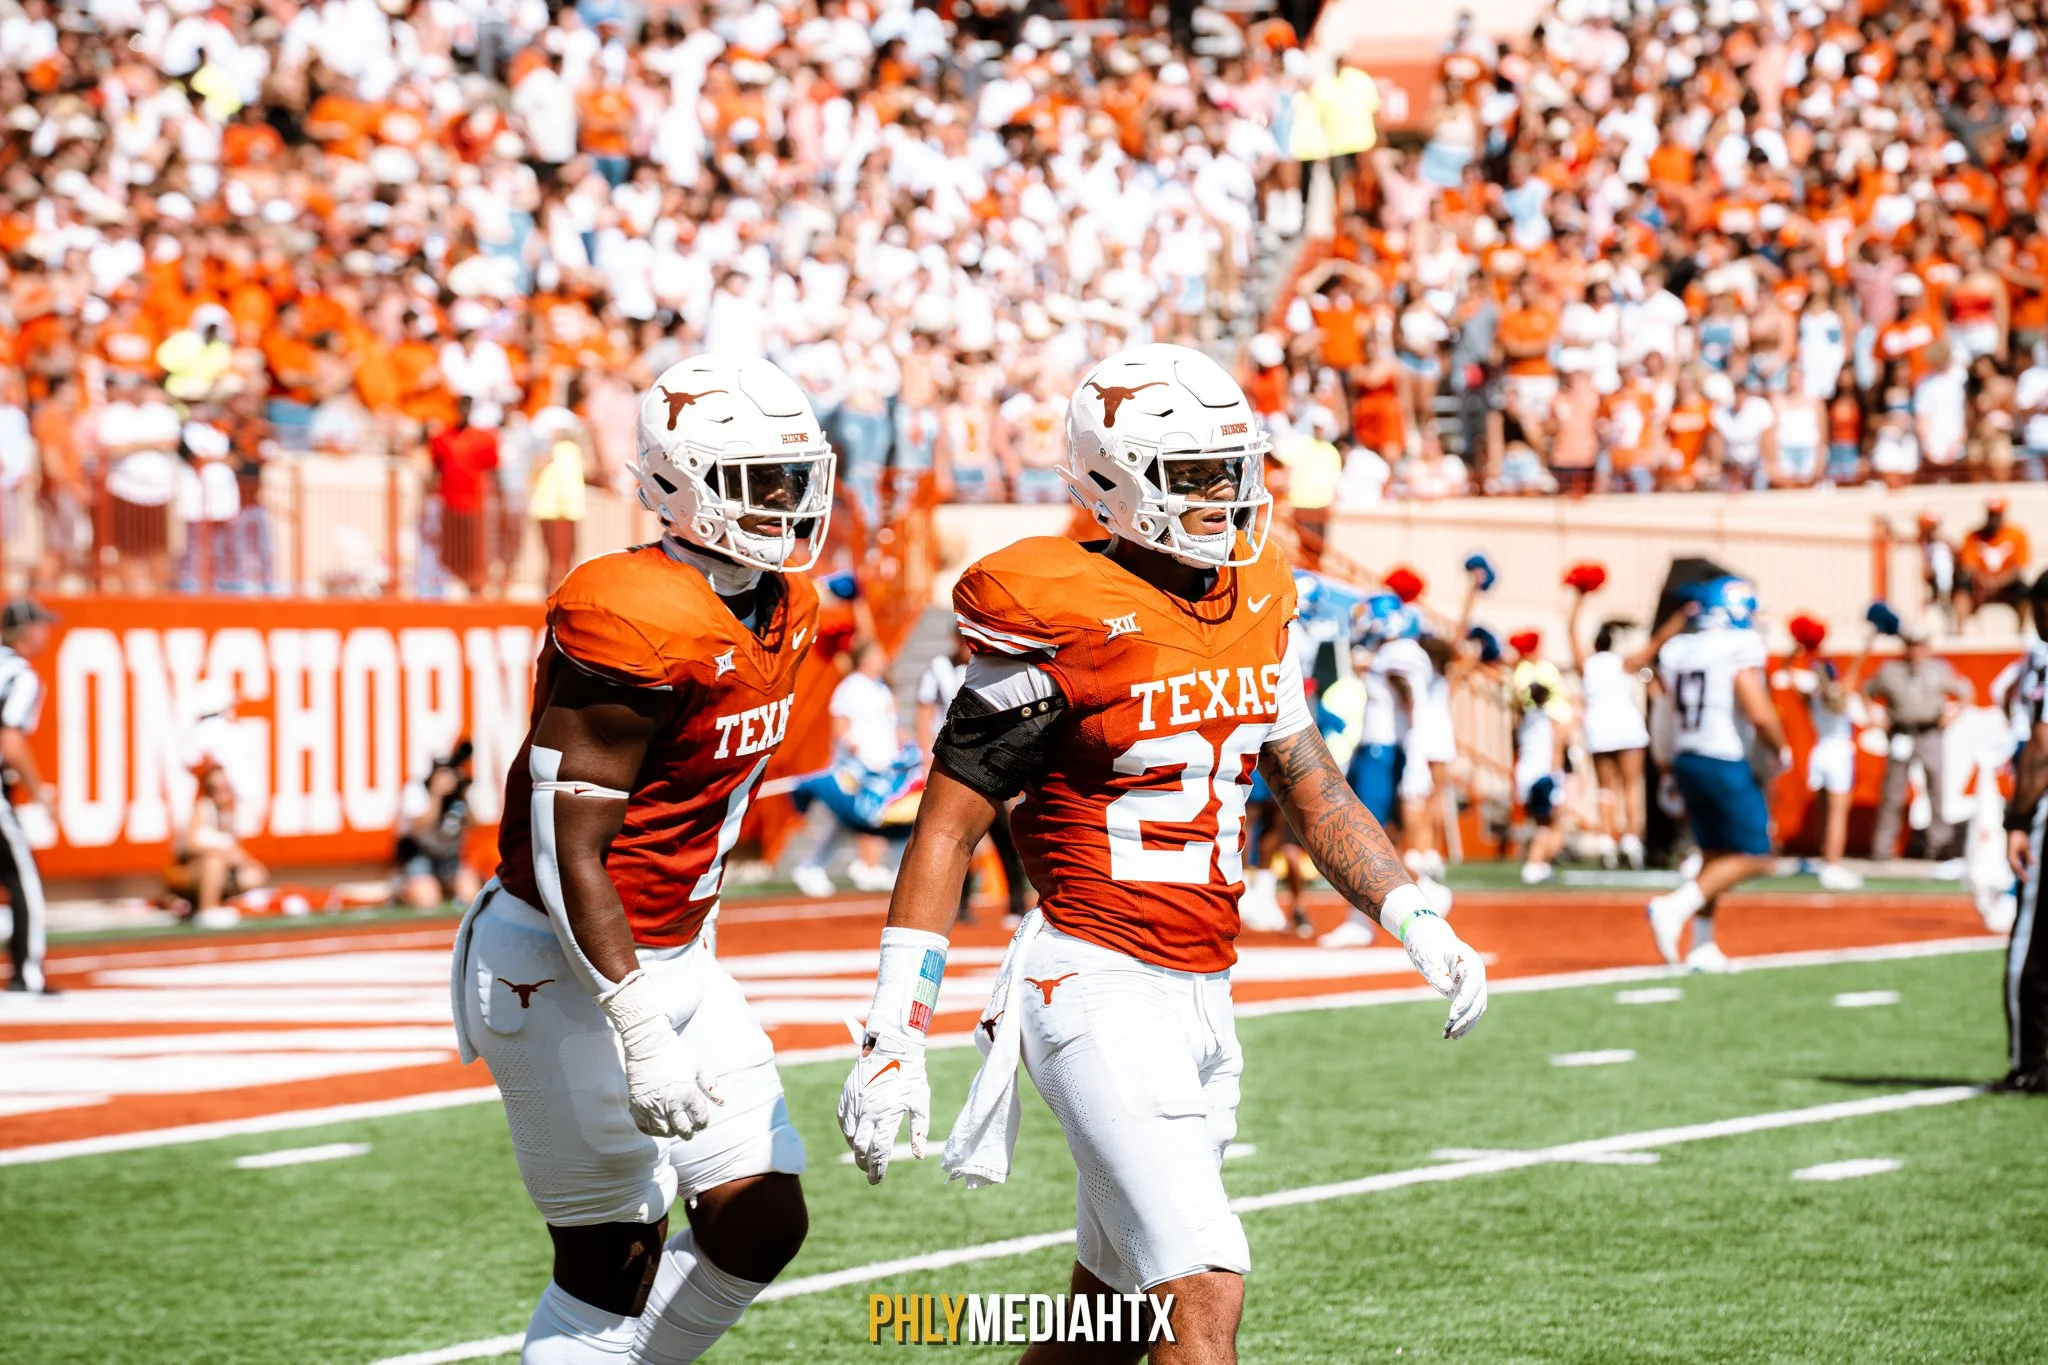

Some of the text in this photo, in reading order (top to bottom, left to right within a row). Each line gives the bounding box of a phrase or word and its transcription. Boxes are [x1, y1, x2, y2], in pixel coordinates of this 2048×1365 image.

[714, 692, 795, 760] TEXA
[1130, 663, 1280, 731] TEXAS
[17, 627, 547, 849] ONGHORN
